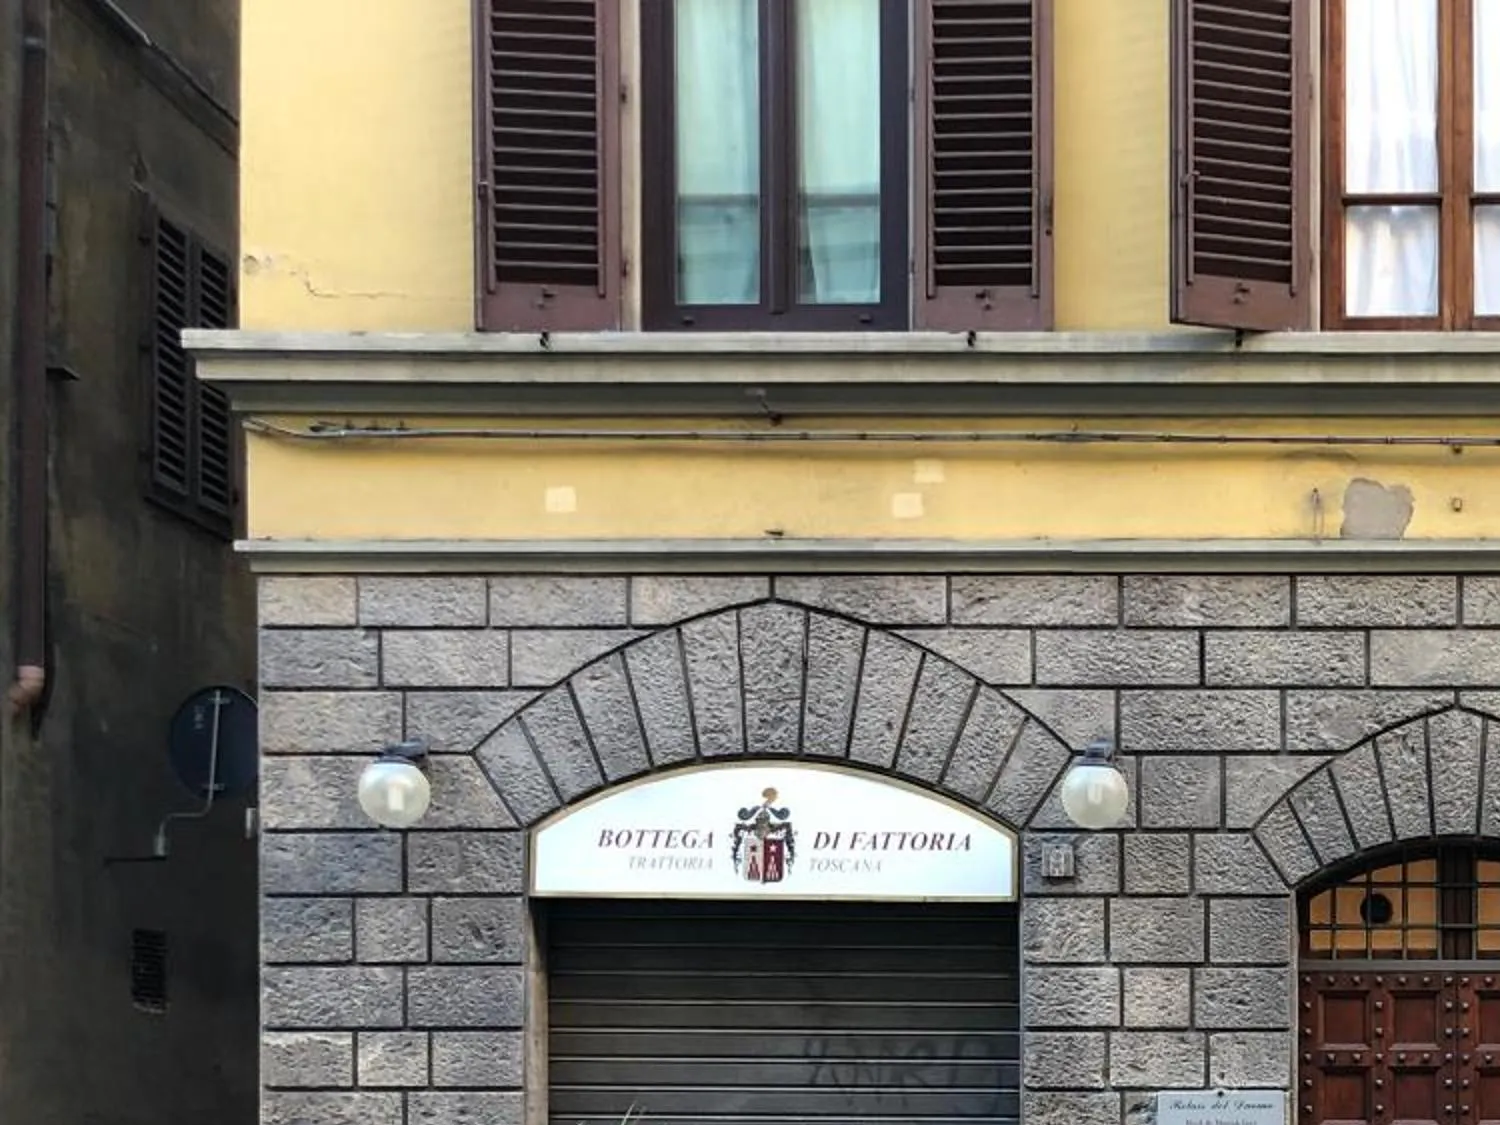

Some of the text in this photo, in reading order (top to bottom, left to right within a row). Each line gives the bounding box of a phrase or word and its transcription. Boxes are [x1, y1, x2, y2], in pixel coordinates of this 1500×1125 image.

[598, 829, 971, 851] BOTTEGA DI FATTORIA
[629, 856, 882, 872] TRATTORIA TOSCANA
